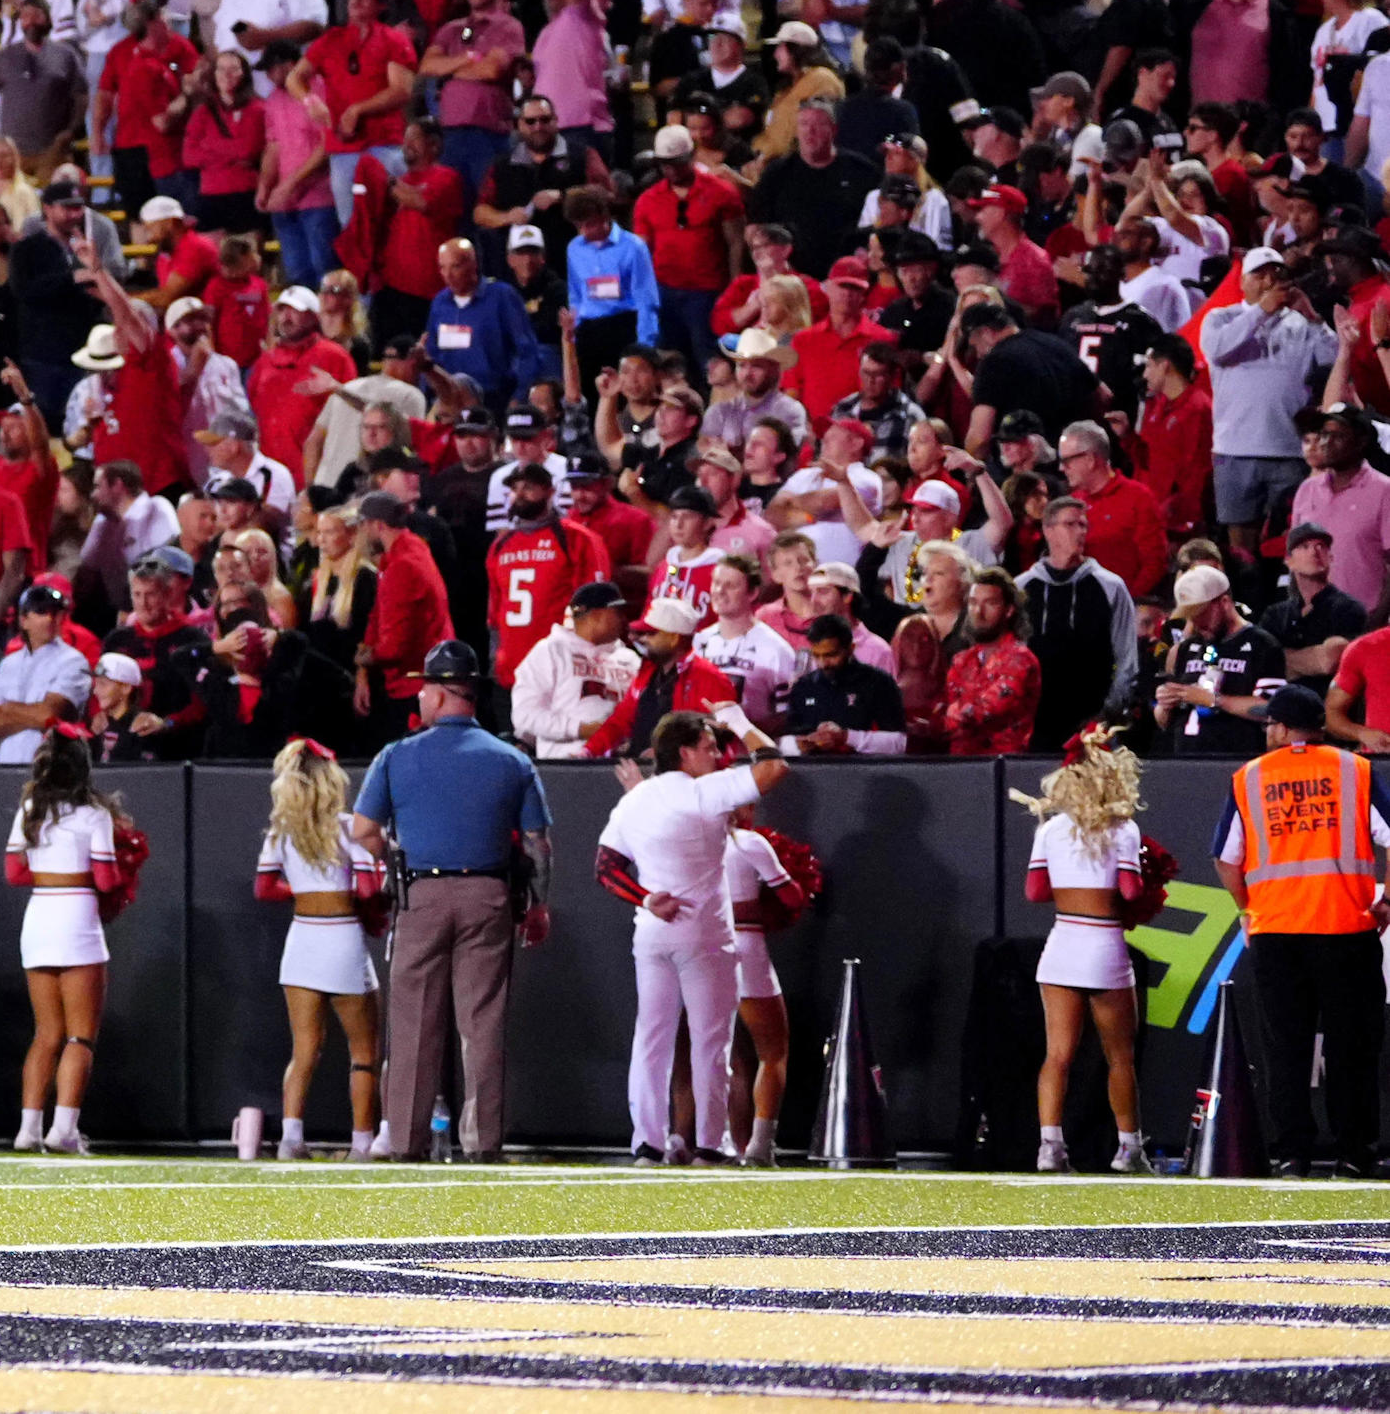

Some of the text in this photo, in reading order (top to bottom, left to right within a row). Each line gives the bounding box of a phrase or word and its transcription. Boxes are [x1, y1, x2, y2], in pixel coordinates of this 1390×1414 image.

[505, 568, 536, 627] 5
[1265, 778, 1332, 803] argus
[1267, 801, 1337, 821] EVENT
[1269, 818, 1338, 837] STAFF
